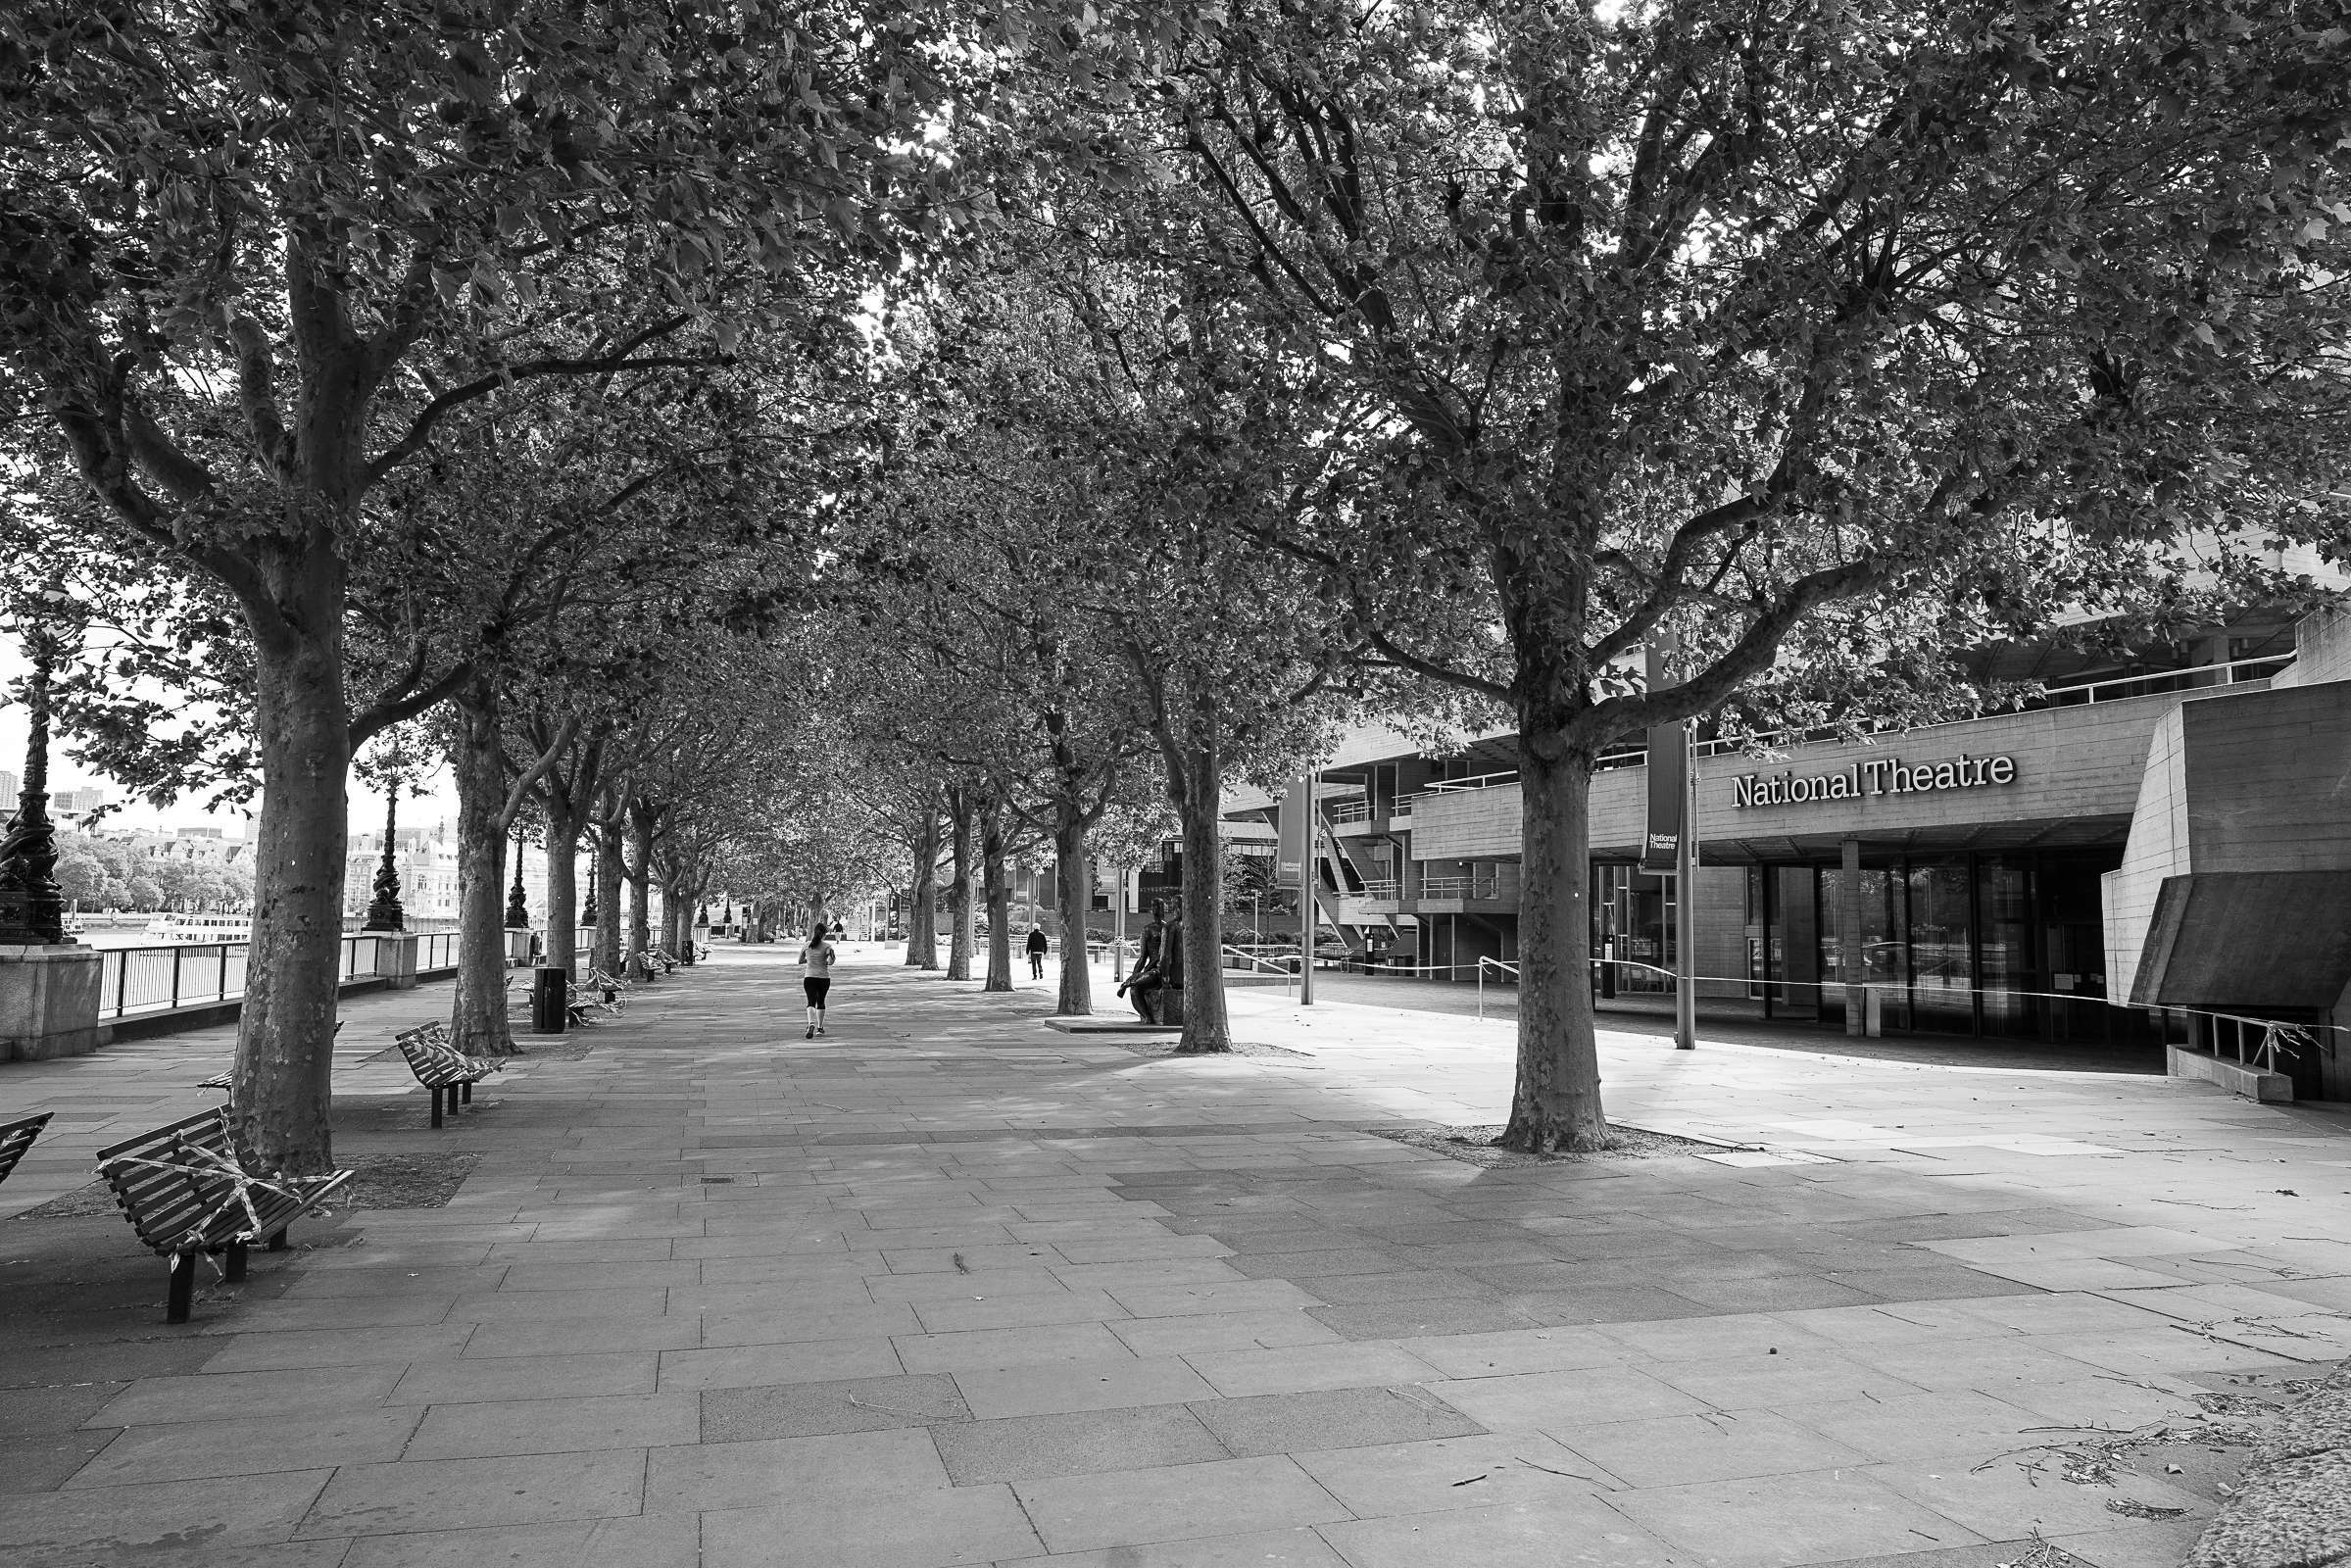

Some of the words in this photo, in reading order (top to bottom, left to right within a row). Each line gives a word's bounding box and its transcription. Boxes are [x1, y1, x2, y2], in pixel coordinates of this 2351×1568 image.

[1731, 762, 1861, 808] National
[1864, 753, 2015, 796] Theatre
[1649, 833, 1678, 842] National
[1649, 840, 1676, 850] Theatre
